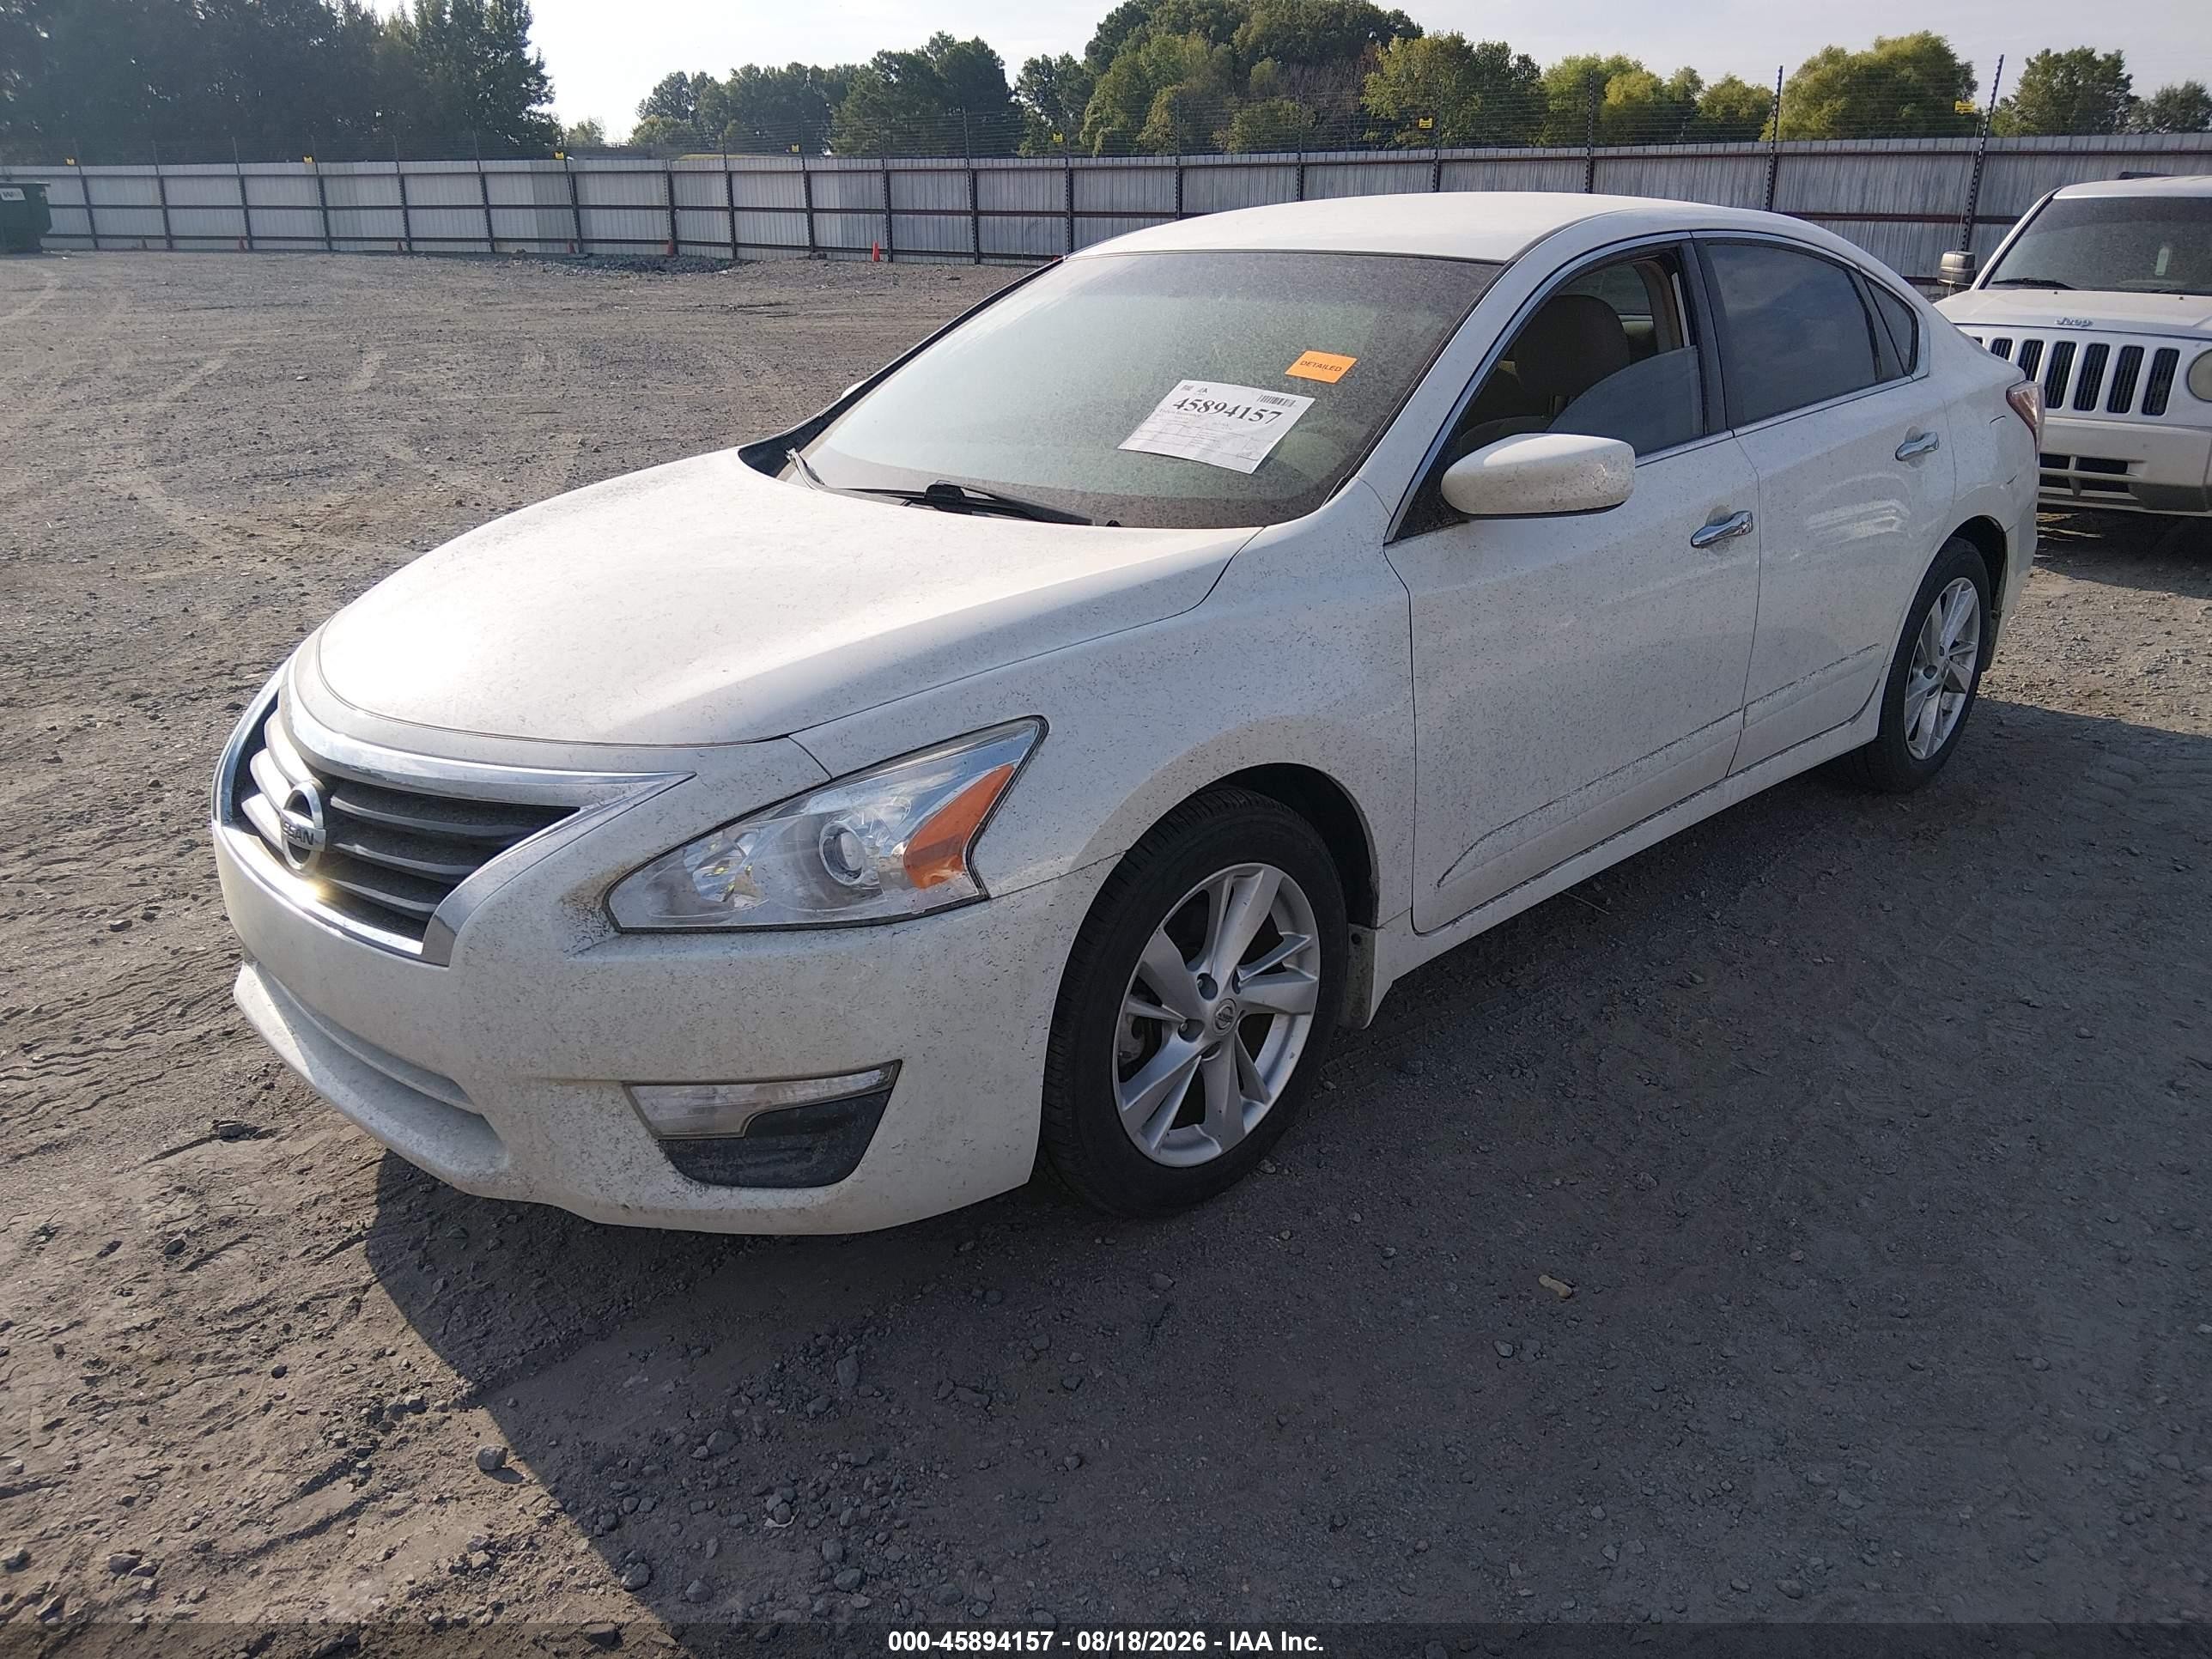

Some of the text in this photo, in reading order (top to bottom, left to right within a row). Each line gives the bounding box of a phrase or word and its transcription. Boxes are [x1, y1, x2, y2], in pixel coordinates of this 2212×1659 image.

[2055, 316, 2094, 328] Jeep
[1299, 360, 1343, 372] DETAILED
[1172, 397, 1284, 425] 45894157
